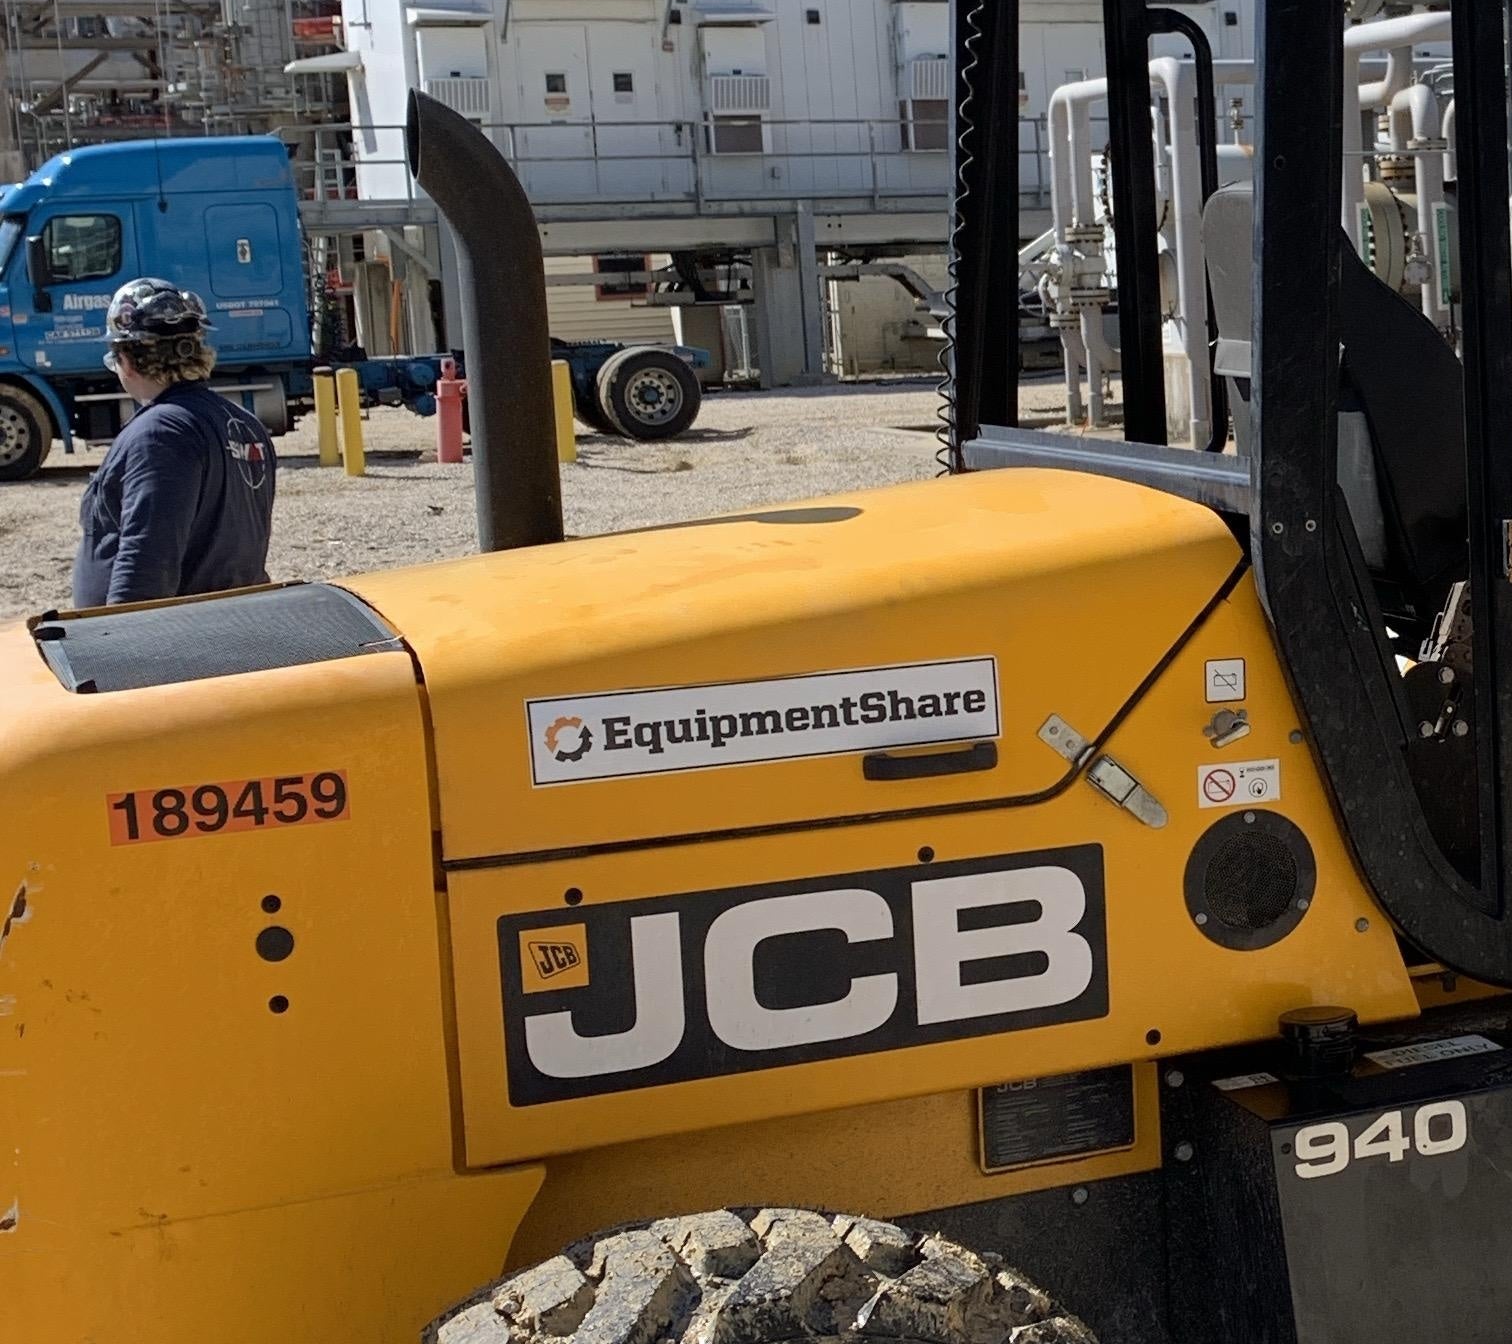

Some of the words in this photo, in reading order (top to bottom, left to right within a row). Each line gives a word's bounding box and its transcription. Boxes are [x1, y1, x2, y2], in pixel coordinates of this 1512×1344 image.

[63, 293, 112, 311] Airgas
[601, 688, 987, 754] EquipmentShare
[112, 771, 347, 840] 189459
[524, 864, 1094, 1079] JCB
[538, 942, 579, 975] JCB
[1294, 1099, 1468, 1179] 940
